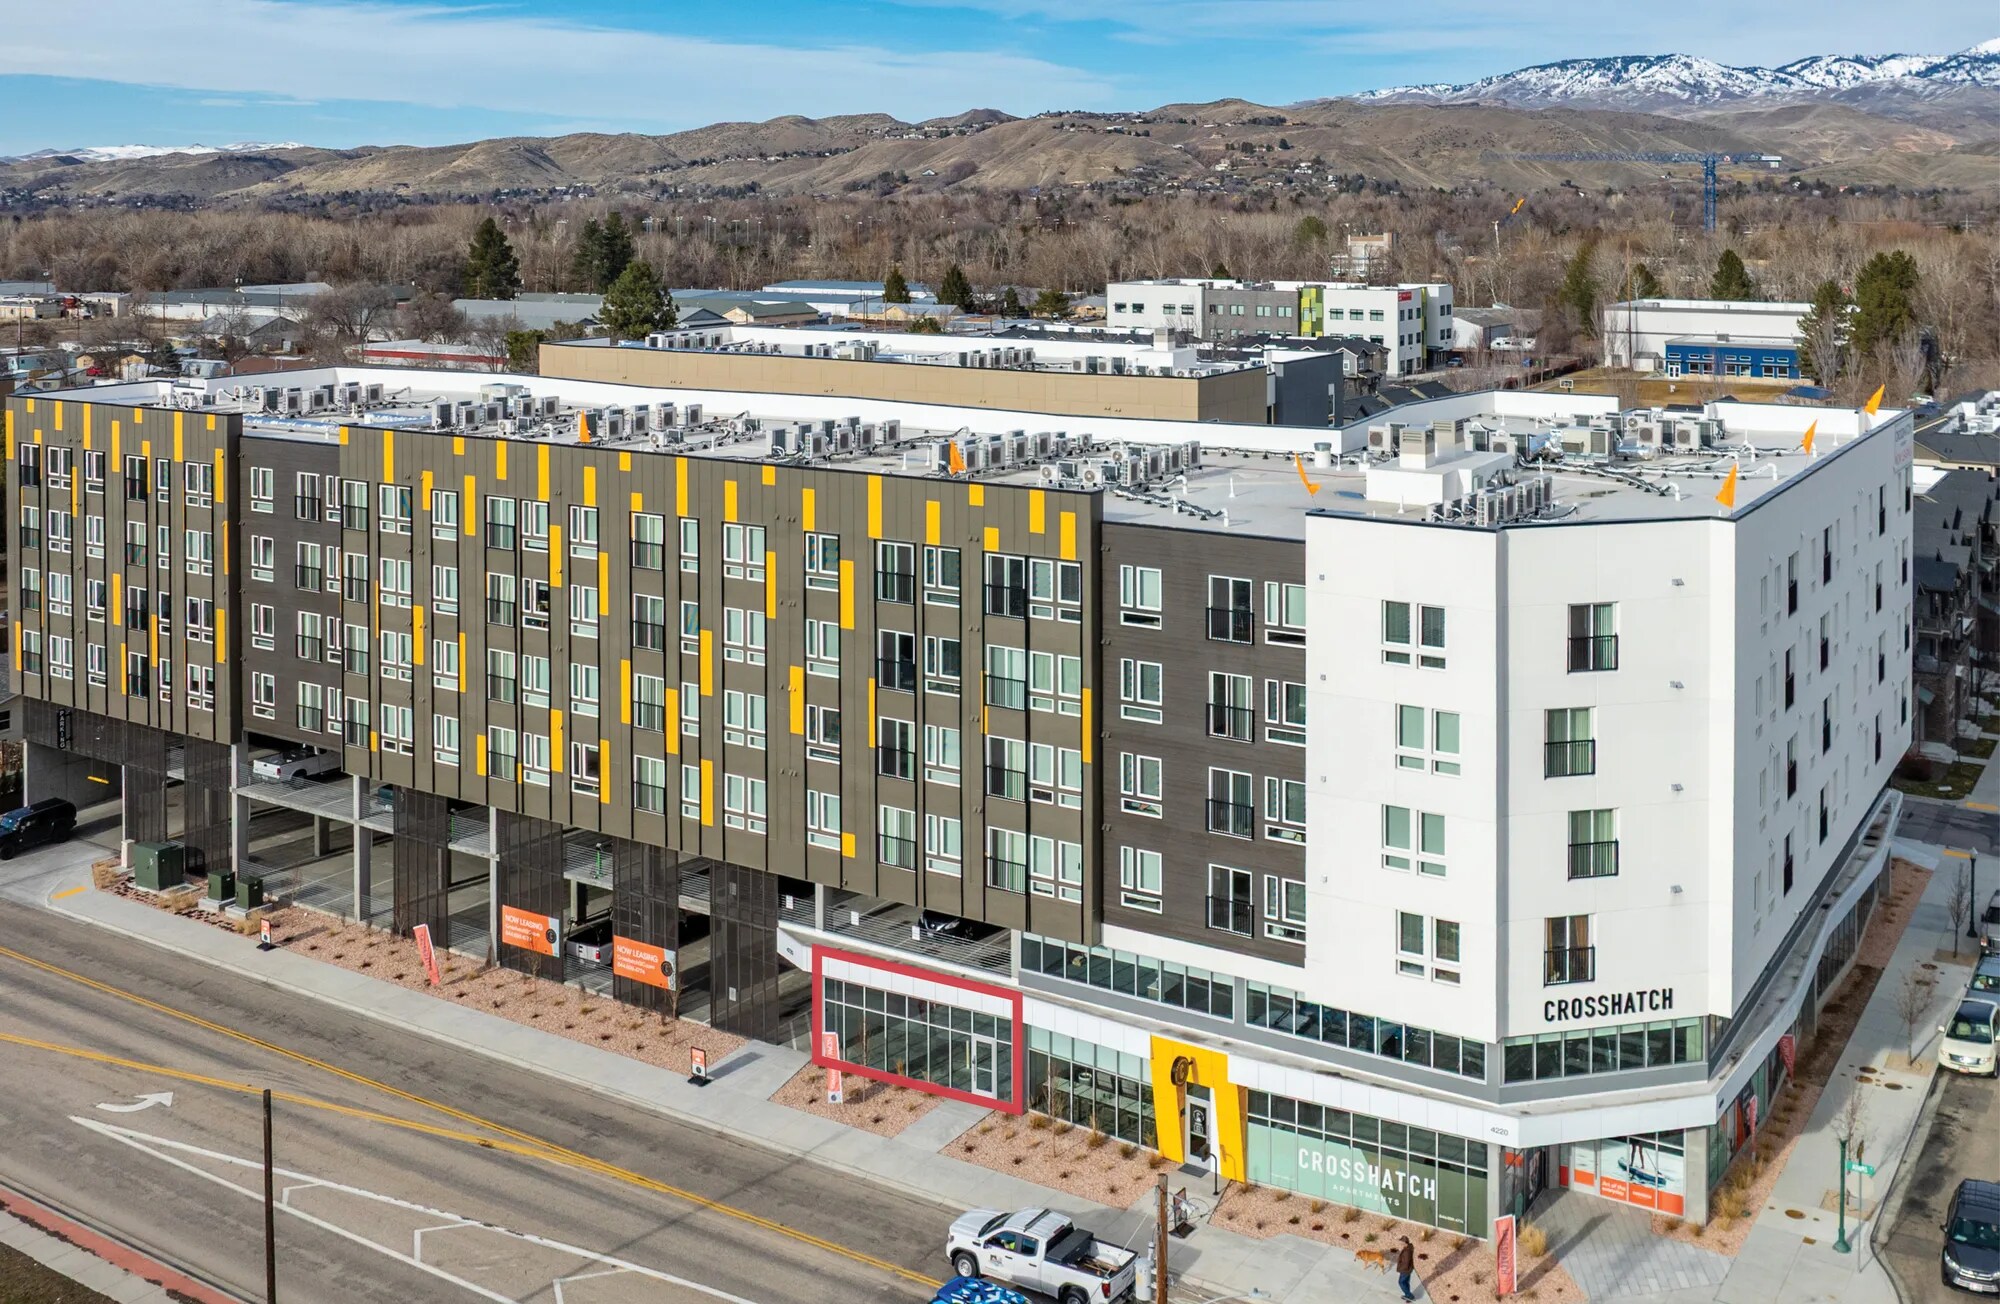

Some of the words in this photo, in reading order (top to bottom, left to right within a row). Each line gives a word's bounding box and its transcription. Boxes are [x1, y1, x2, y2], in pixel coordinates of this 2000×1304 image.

[505, 914, 520, 925] NOW
[519, 918, 544, 931] LEASING
[617, 944, 633, 956] NOW
[632, 949, 659, 963] LEASING
[1544, 988, 1673, 1022] CROSSHATCH
[1490, 1126, 1509, 1137] 4220
[1299, 1148, 1436, 1201] CROSSHATCH
[1333, 1184, 1400, 1206] APARTMENTS
